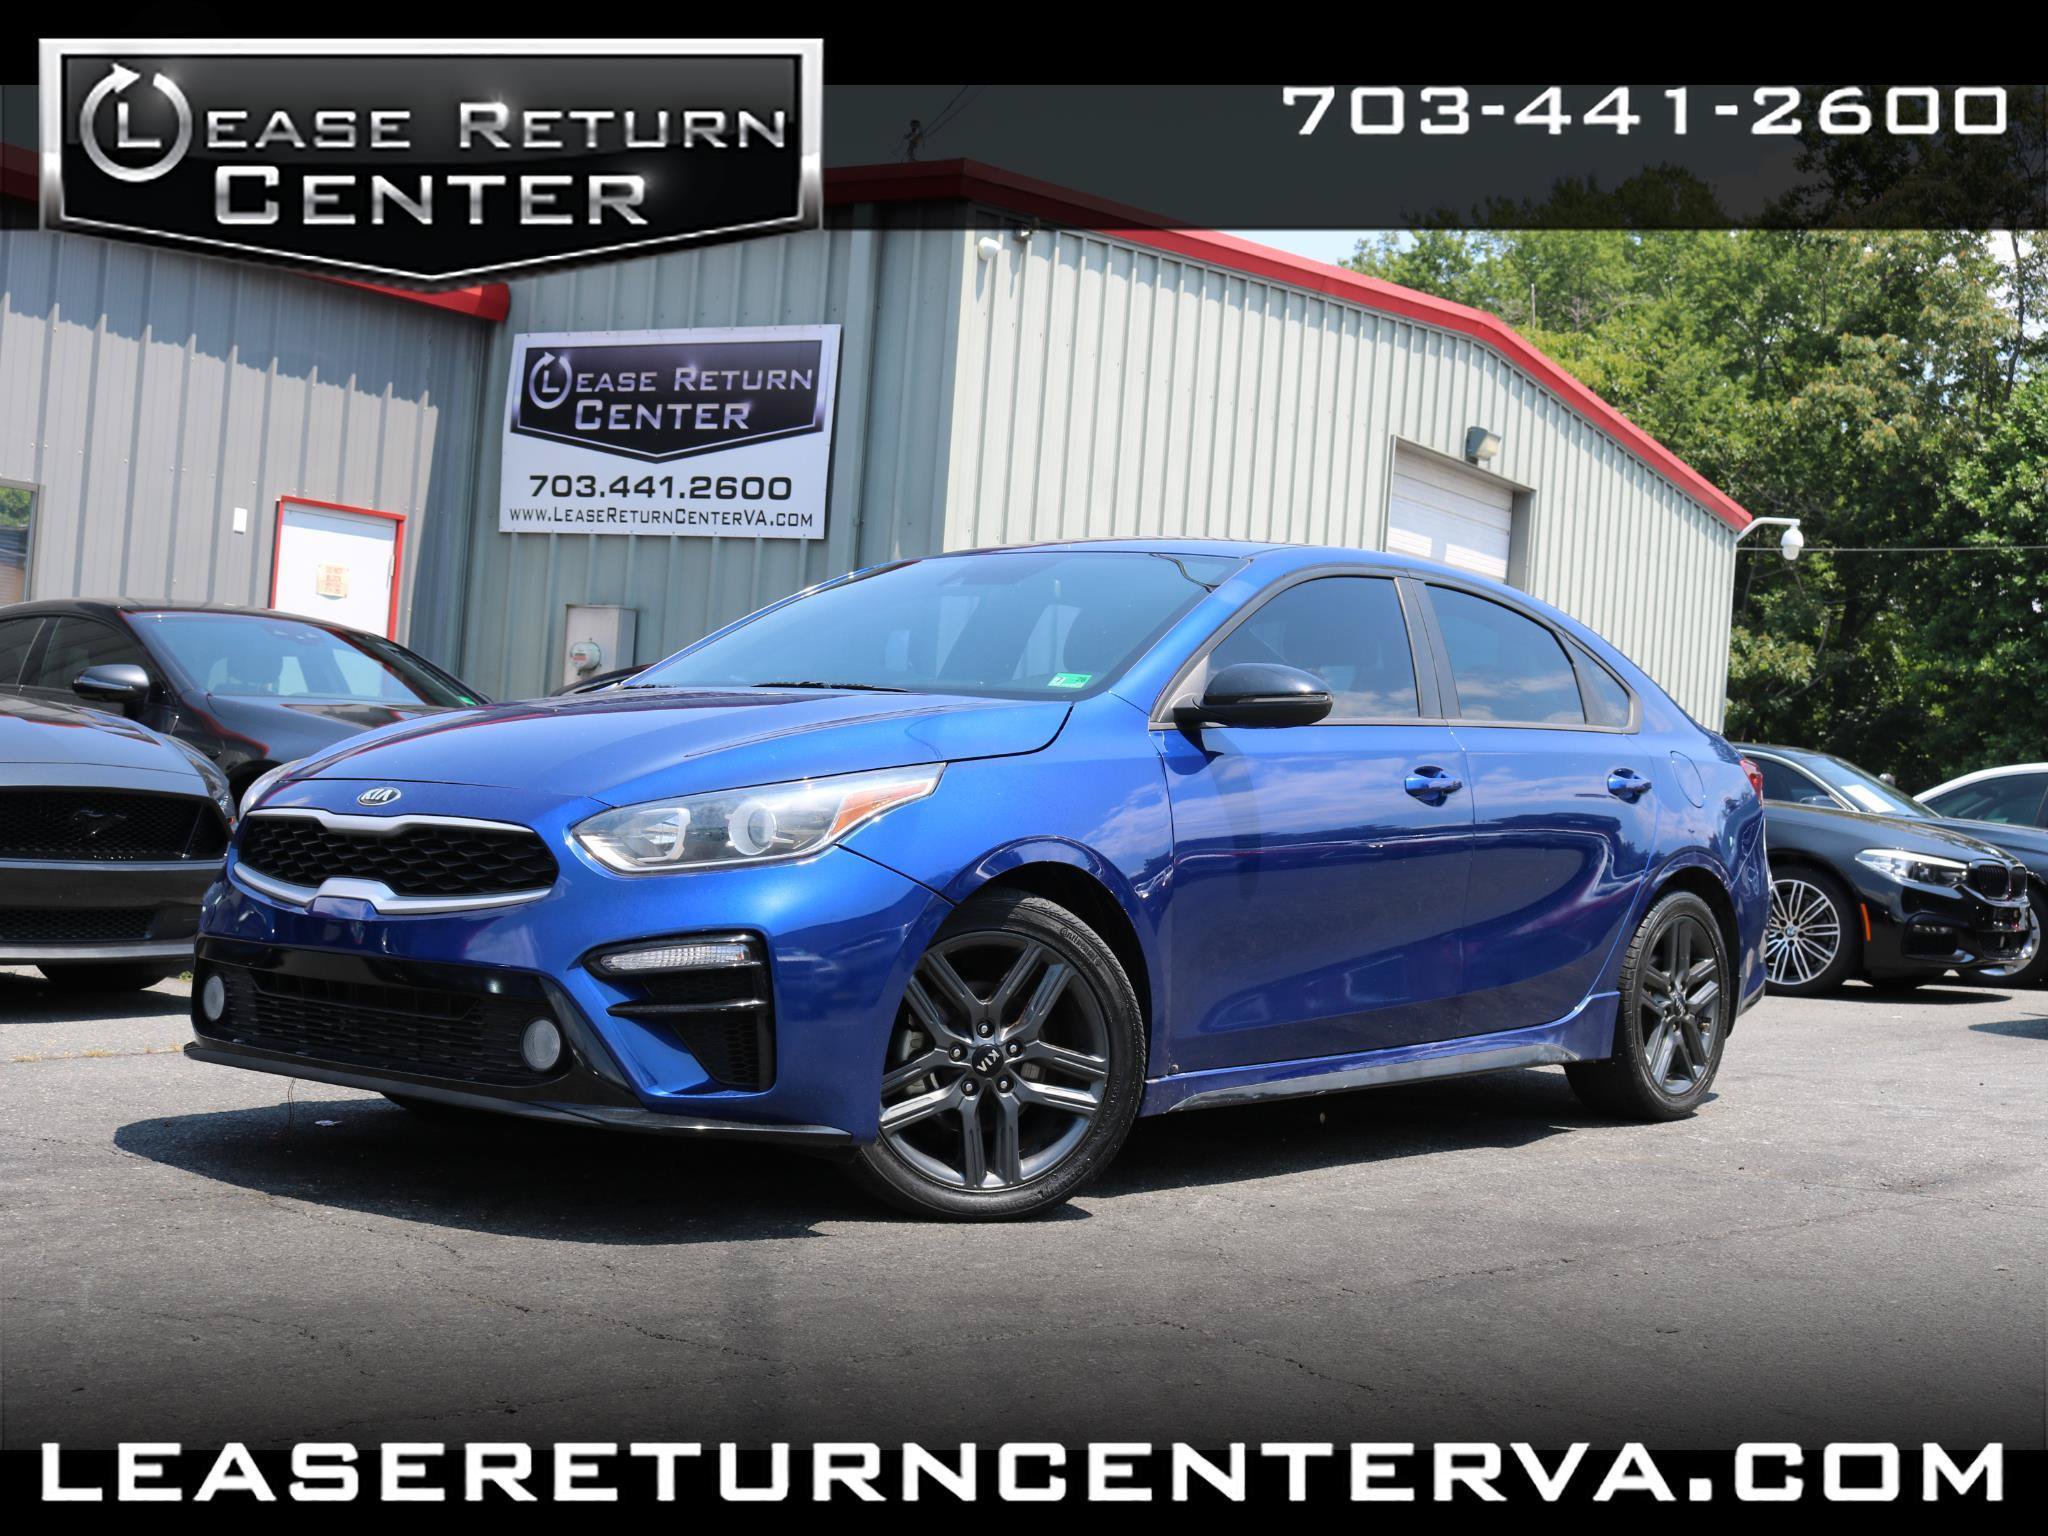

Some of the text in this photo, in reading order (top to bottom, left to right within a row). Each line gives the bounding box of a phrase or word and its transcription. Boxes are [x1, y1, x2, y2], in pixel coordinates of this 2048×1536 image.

[541, 367, 812, 393] LEASE RETURN
[575, 399, 750, 431] CENTER
[529, 475, 793, 501] 703.441.2600
[360, 788, 396, 803] KIA
[976, 1049, 1000, 1072] KIA
